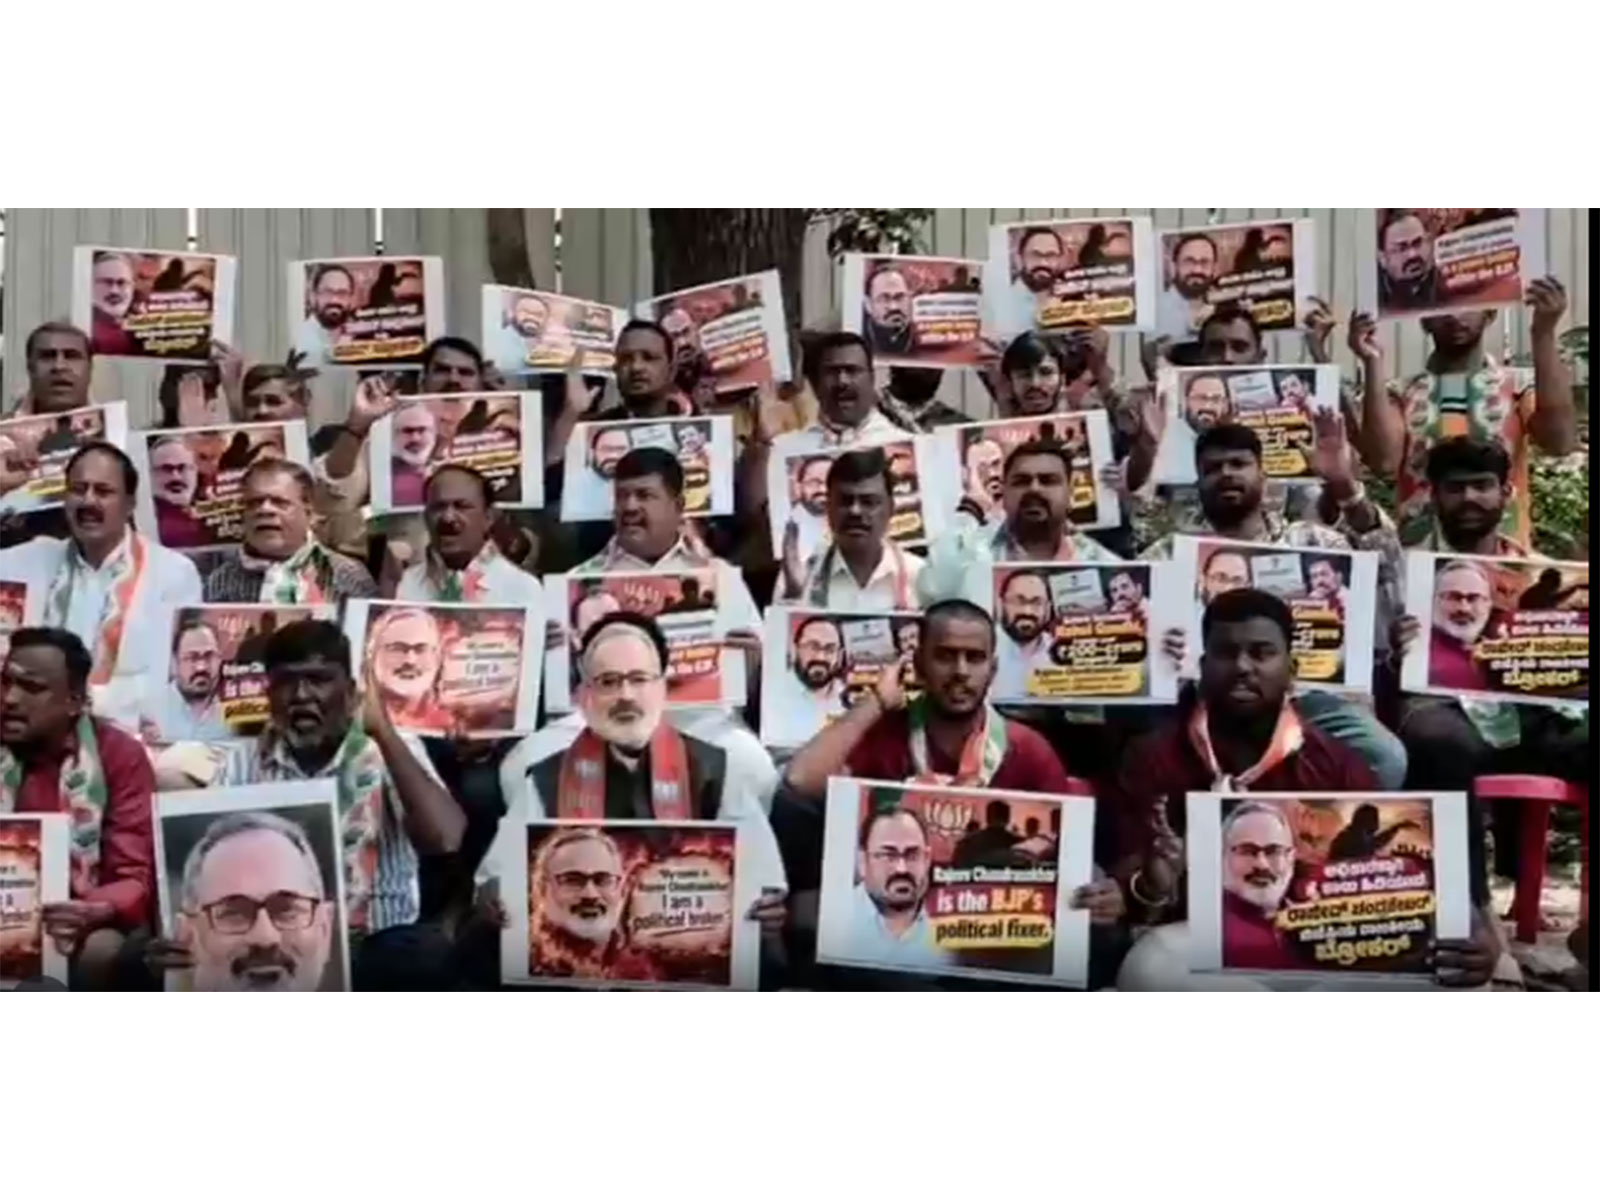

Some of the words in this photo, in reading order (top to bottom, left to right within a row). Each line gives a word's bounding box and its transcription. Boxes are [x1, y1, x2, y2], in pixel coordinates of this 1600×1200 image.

[936, 888, 954, 913] is
[956, 888, 989, 912] the
[935, 919, 1004, 944] political
